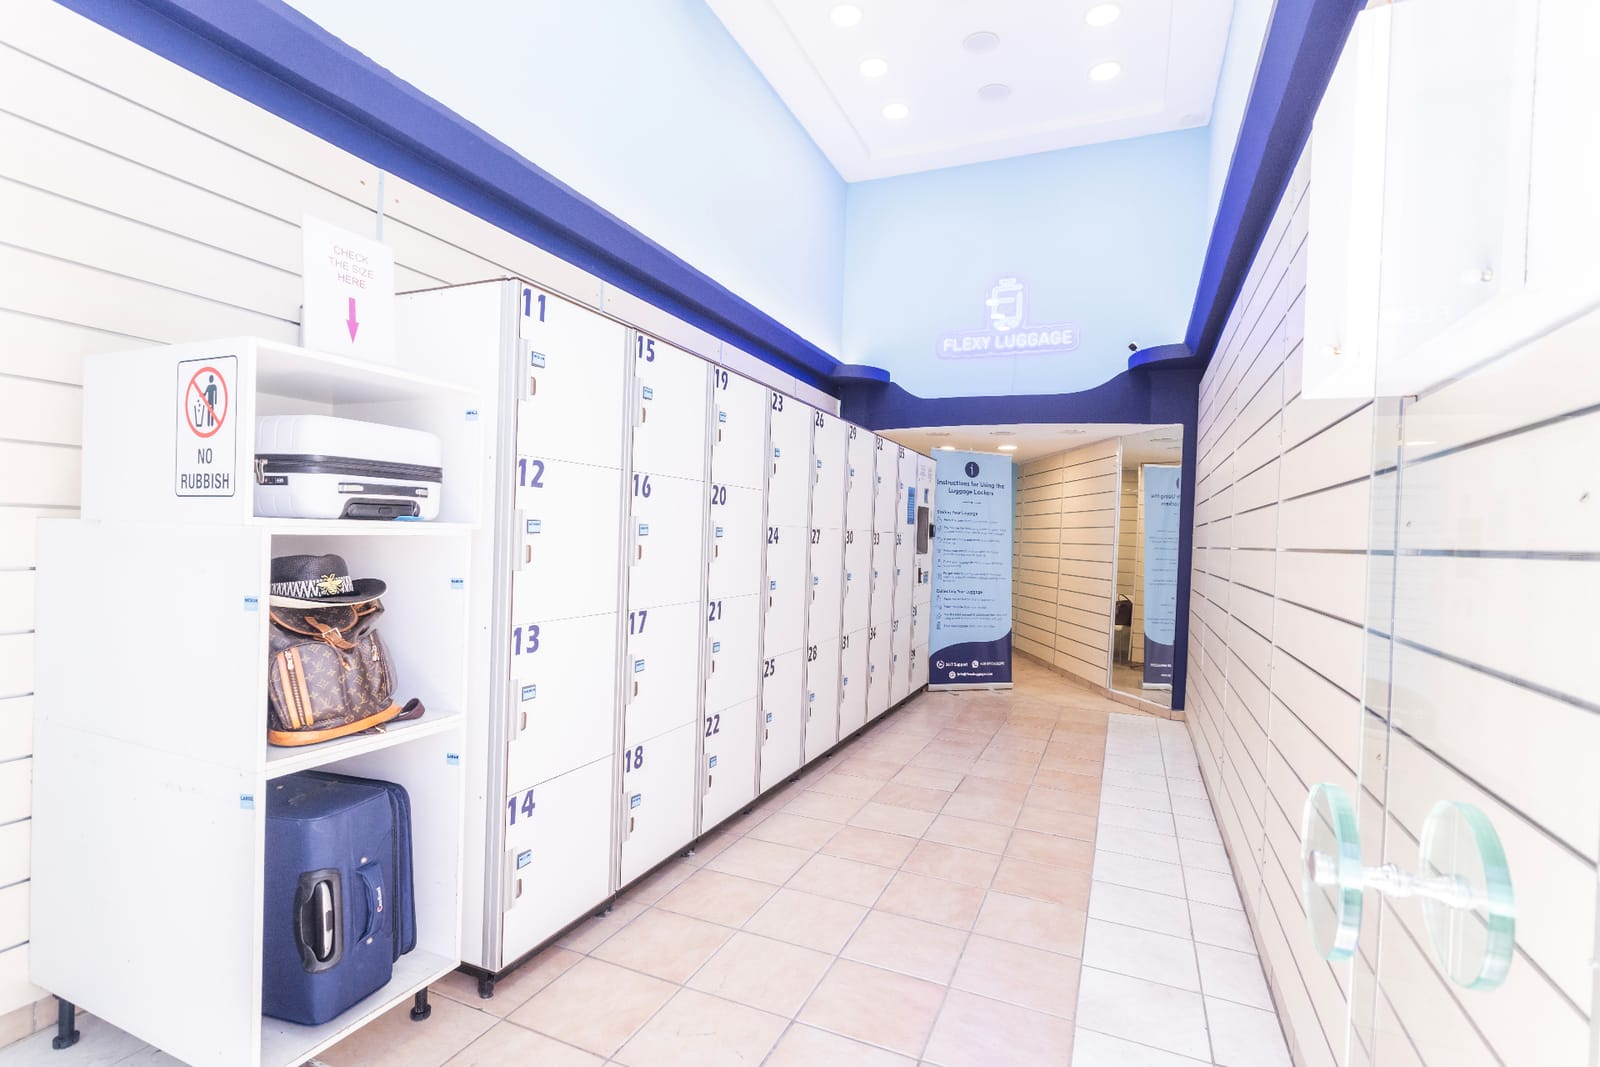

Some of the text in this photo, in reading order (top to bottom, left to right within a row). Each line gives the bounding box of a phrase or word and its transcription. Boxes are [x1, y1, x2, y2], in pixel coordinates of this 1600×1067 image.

[333, 245, 369, 265] CHECK
[328, 256, 375, 280] THE SIZE
[337, 271, 367, 289] HERE
[523, 288, 546, 322] 11
[638, 335, 655, 362] 15
[943, 329, 1073, 352] FLEXY LUGGAGE
[715, 369, 728, 390] 19
[772, 393, 783, 412] 23
[815, 411, 824, 428] 26
[849, 425, 857, 440] 29
[197, 448, 213, 464] NO
[180, 472, 230, 489] RUBBISH
[518, 458, 545, 488] 12
[936, 479, 970, 487] Instructions
[634, 474, 652, 498] 16
[711, 485, 727, 506] 20
[948, 487, 973, 496] Luggage
[768, 527, 779, 544] 24
[811, 529, 821, 544] 27
[846, 530, 854, 544] 30
[873, 532, 880, 545] 33
[708, 600, 722, 621] 21
[629, 610, 647, 635] 17
[513, 625, 540, 656] 13
[841, 634, 849, 650] 31
[807, 645, 818, 662] 28
[764, 658, 775, 678] 25
[705, 714, 720, 738] 22
[625, 745, 643, 773] 18
[508, 789, 536, 826] 14
